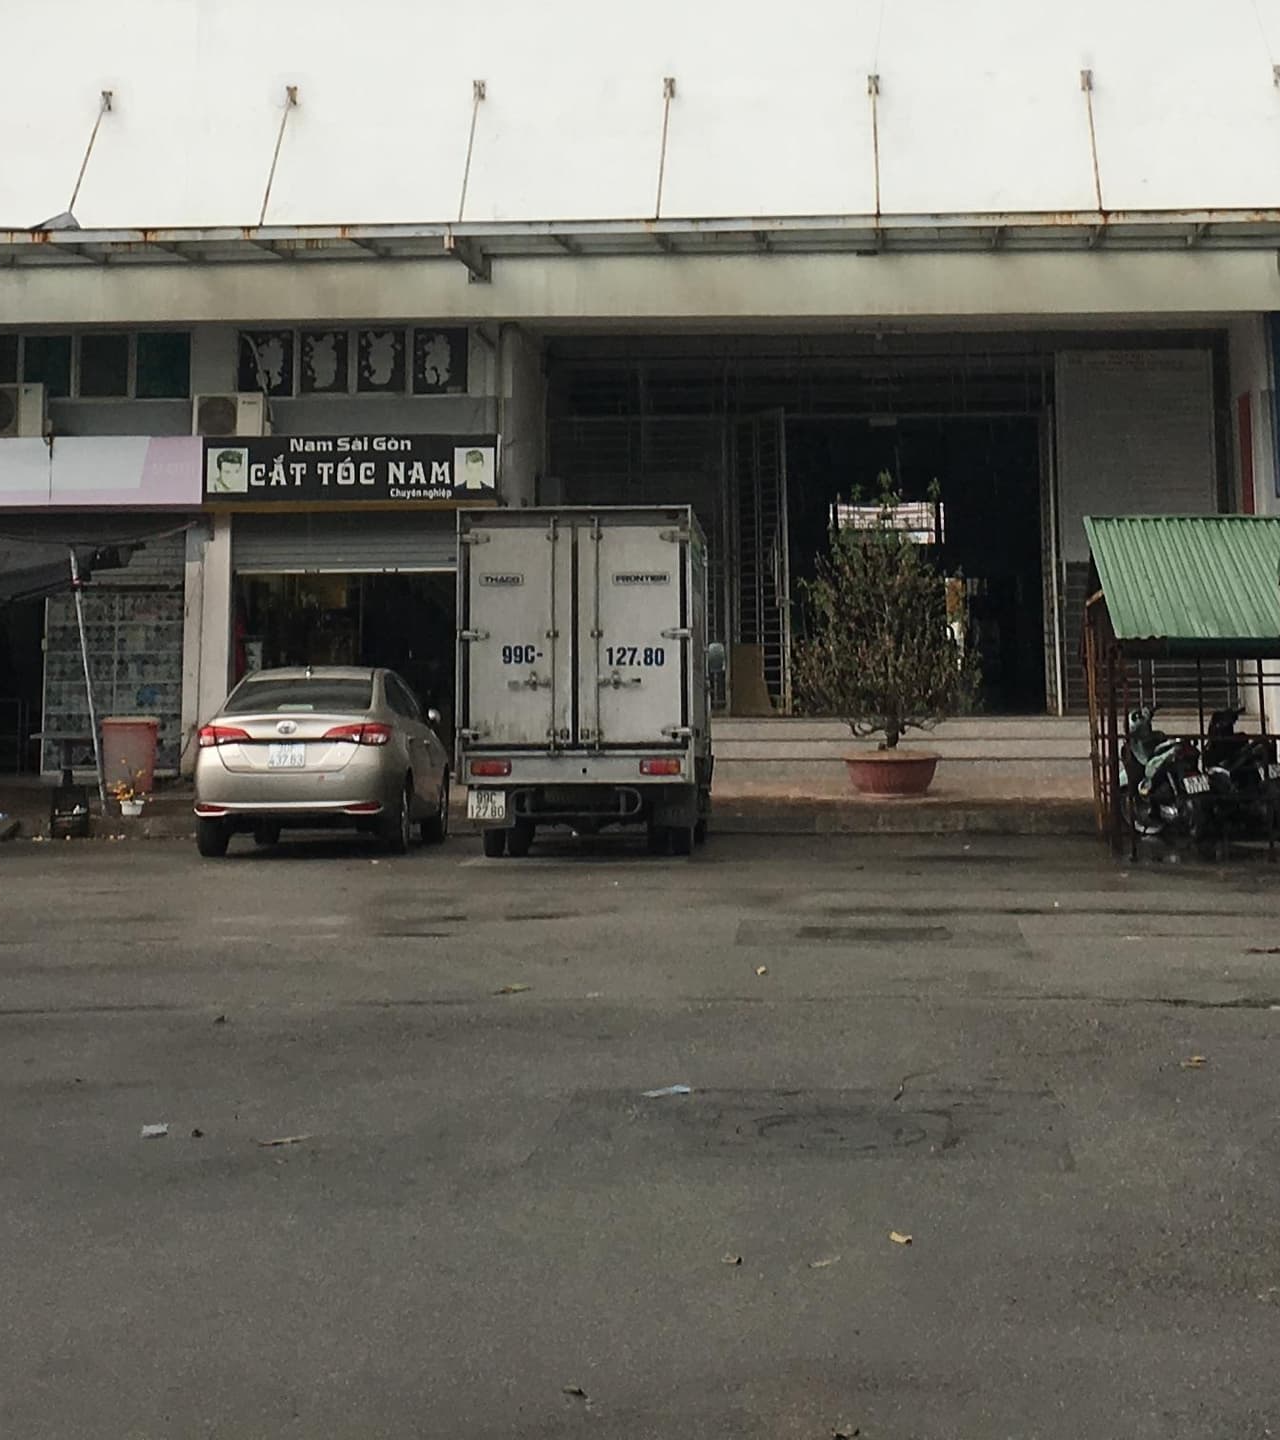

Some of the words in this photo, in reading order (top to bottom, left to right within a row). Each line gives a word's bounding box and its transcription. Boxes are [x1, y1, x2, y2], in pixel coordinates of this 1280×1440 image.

[289, 438, 334, 452] Nam
[336, 436, 369, 452] Sài
[372, 436, 412, 452] Gòn
[249, 454, 307, 486] CẮT
[317, 456, 376, 486] TÓC
[387, 461, 451, 486] NAM
[389, 487, 423, 500] Chuyên
[484, 575, 521, 585] THACO
[605, 647, 665, 666] 127.80
